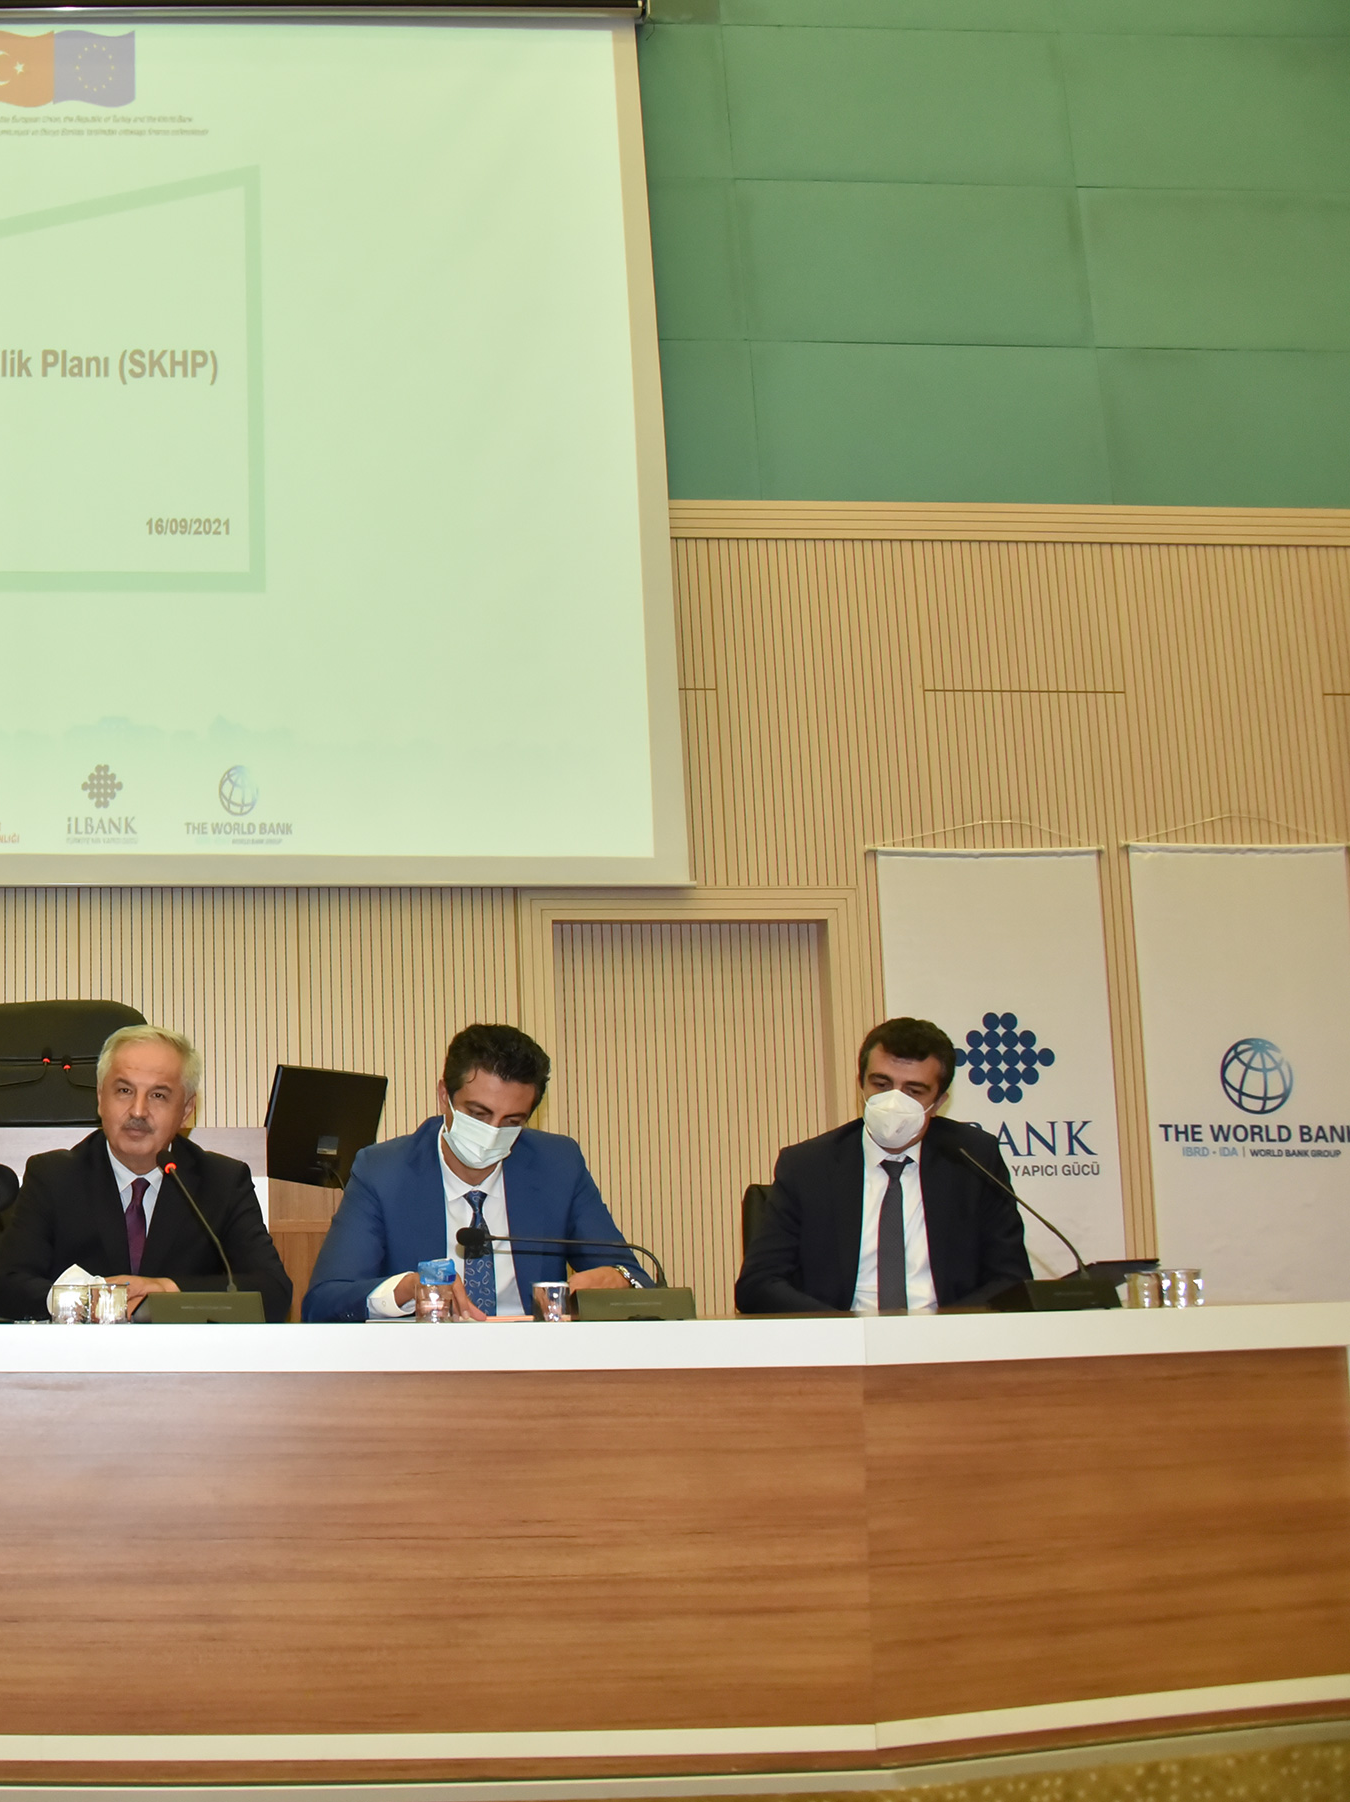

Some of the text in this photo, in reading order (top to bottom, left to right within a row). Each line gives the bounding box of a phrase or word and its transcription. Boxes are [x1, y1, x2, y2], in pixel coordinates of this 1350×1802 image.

[41, 350, 110, 378] Planı
[119, 350, 218, 386] (SKHP)
[146, 518, 231, 536] 16/09/2021
[184, 822, 293, 836] THE WORLD BANK
[959, 1120, 1098, 1156] ANK
[1158, 1124, 1204, 1142] THE
[1209, 1124, 1292, 1142] WORLD
[1182, 1146, 1342, 1158] IBRD IDA WORLD BANK GROUP
[1011, 1162, 1100, 1176] YAPICI GÜCÜ
